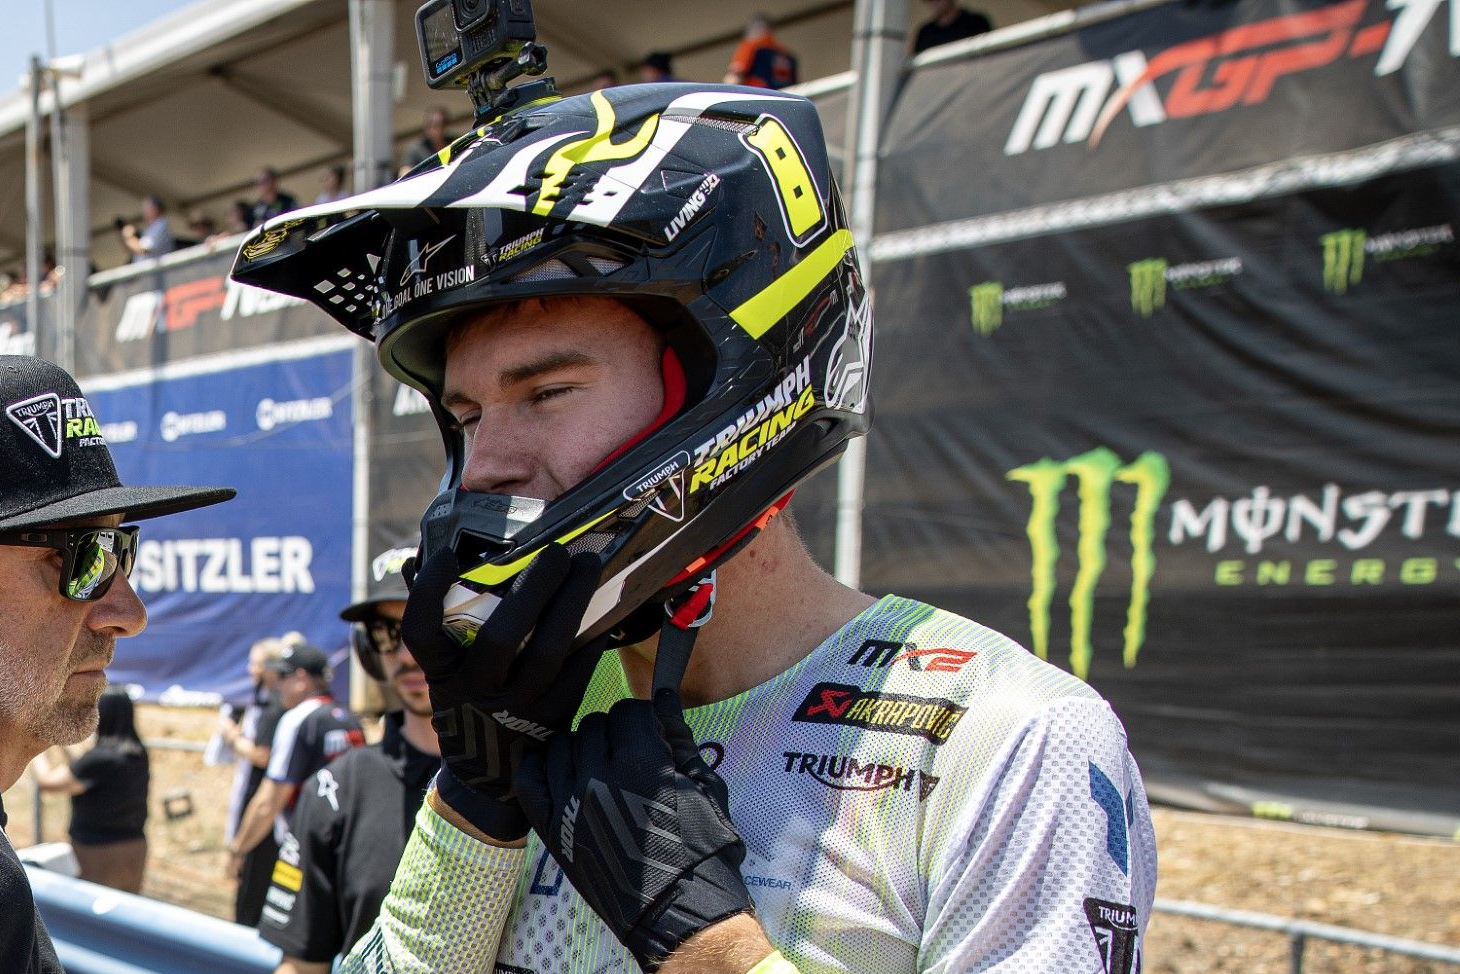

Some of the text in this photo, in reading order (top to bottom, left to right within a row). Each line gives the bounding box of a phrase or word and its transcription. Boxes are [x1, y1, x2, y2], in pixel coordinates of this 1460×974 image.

[499, 237, 542, 261] RACING
[500, 228, 545, 254] TRIUMPH
[394, 289, 412, 309] GOAL
[414, 278, 434, 298] ONE
[436, 265, 475, 290] VISION
[15, 399, 55, 418] TRIUMPH
[694, 355, 811, 467] TRIUMPH
[690, 384, 815, 494] RACING
[710, 421, 797, 490] FACTORY TEAM
[636, 461, 680, 494] TRIUMPH
[847, 639, 978, 673] MX2
[491, 709, 554, 742] THOR
[783, 751, 916, 792] TRIUMPH
[561, 796, 581, 863] THOR
[744, 875, 792, 891] CEWEAR
[1098, 906, 1138, 929] TRIUM
